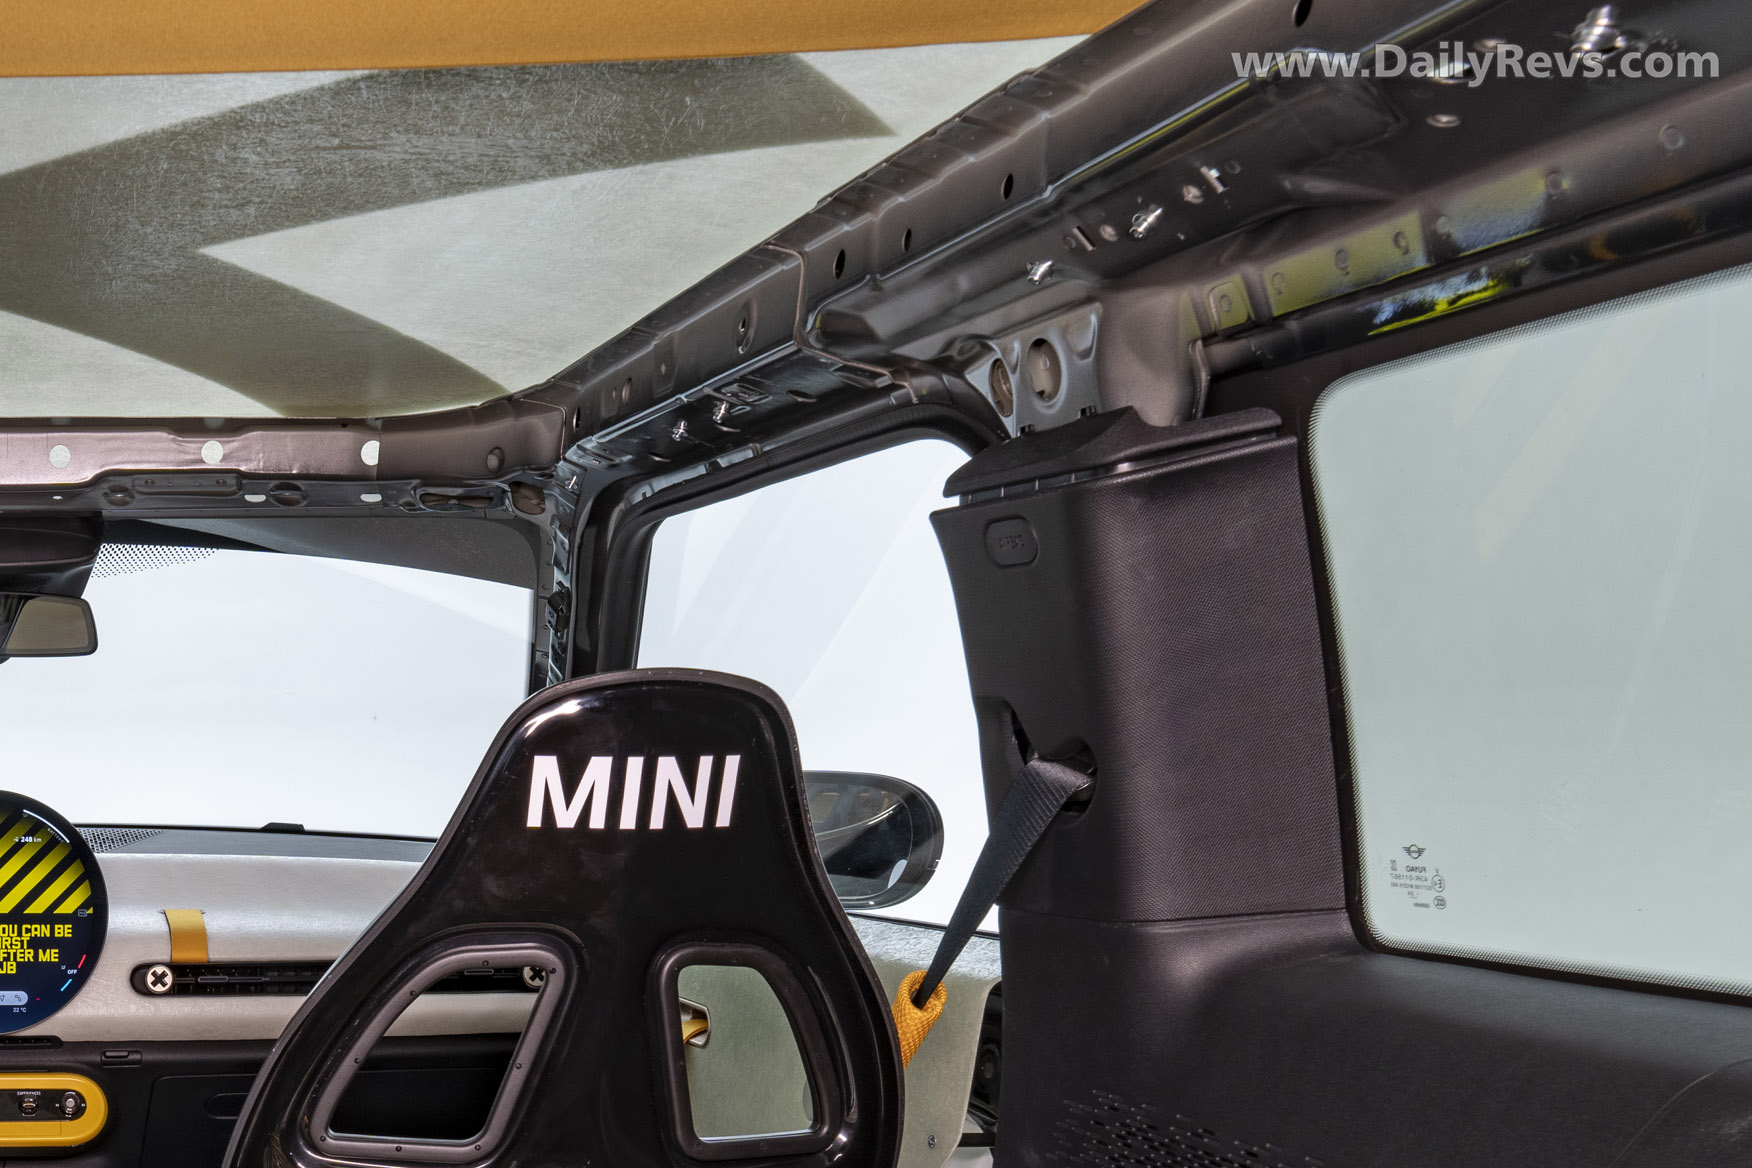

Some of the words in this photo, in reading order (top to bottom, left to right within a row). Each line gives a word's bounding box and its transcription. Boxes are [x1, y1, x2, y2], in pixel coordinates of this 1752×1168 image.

[527, 754, 741, 829] MINI
[22, 924, 50, 937] CAN
[54, 924, 72, 937] BE
[38, 949, 59, 962] ME
